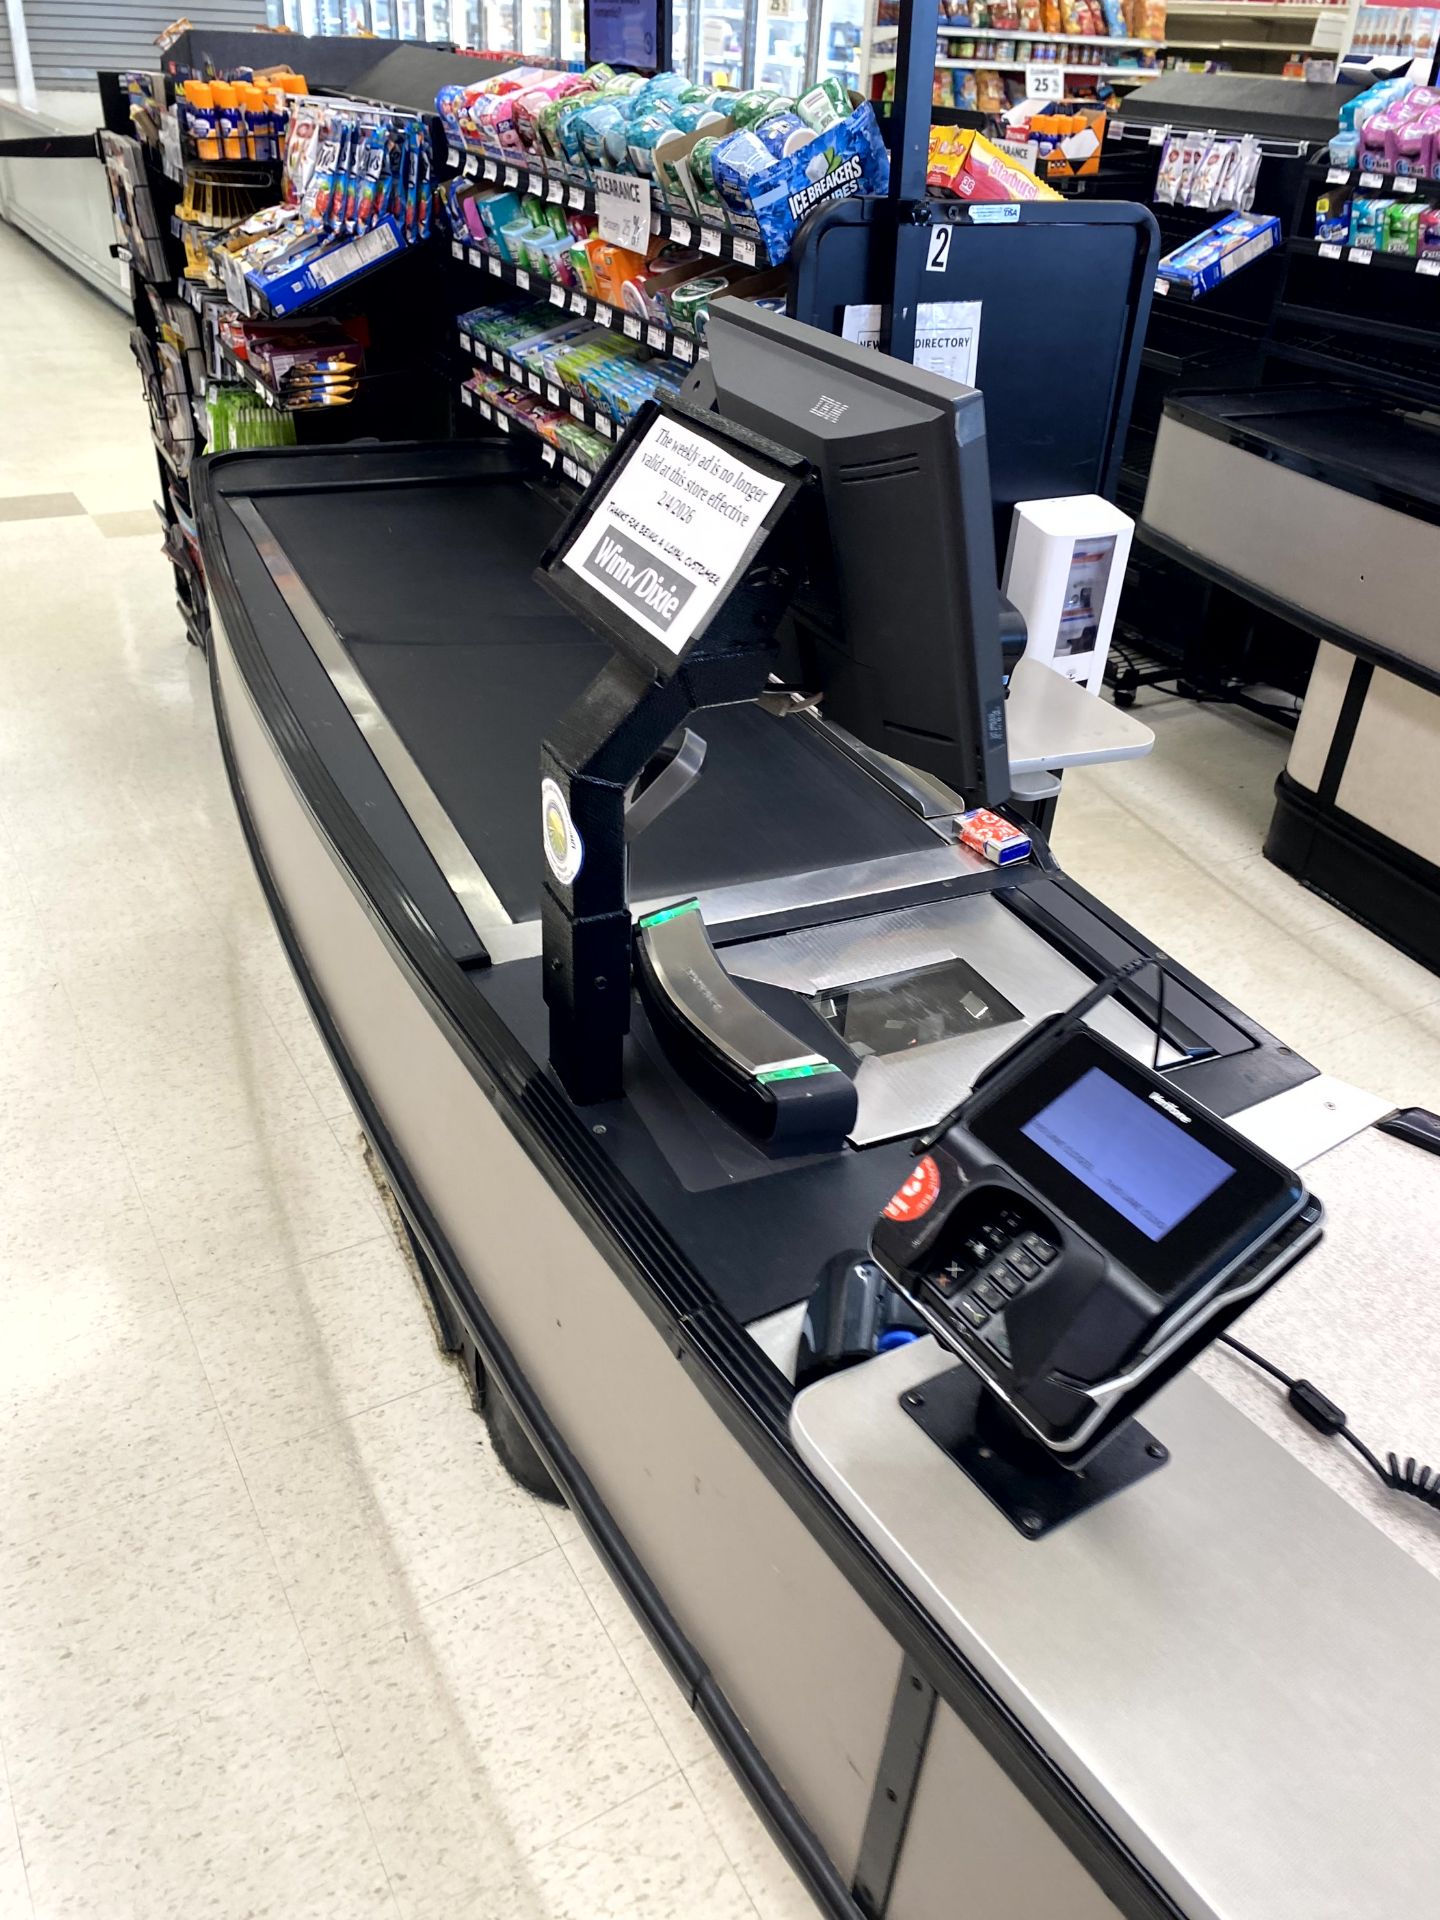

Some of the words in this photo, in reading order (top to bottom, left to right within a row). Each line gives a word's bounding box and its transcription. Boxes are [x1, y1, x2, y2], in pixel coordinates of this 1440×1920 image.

[1034, 78, 1048, 91] 25
[596, 175, 640, 203] CLEARANCE
[808, 155, 862, 209] BREAKERS
[962, 177, 974, 189] 36
[931, 228, 949, 268] 2
[915, 337, 970, 348] DIRECTORY
[809, 395, 848, 424] IBM
[655, 428, 672, 448] The
[672, 439, 700, 466] weekly
[697, 453, 712, 471] ad
[712, 459, 721, 476] is
[719, 468, 734, 484] no
[733, 471, 768, 502] longer
[641, 453, 663, 473] valid
[659, 463, 669, 478] at
[668, 466, 688, 488] this
[686, 478, 708, 501] store
[706, 492, 750, 527] effective
[657, 490, 696, 524] 2/4/2026
[628, 517, 640, 531] FOR
[684, 556, 721, 586] CUSTOMER
